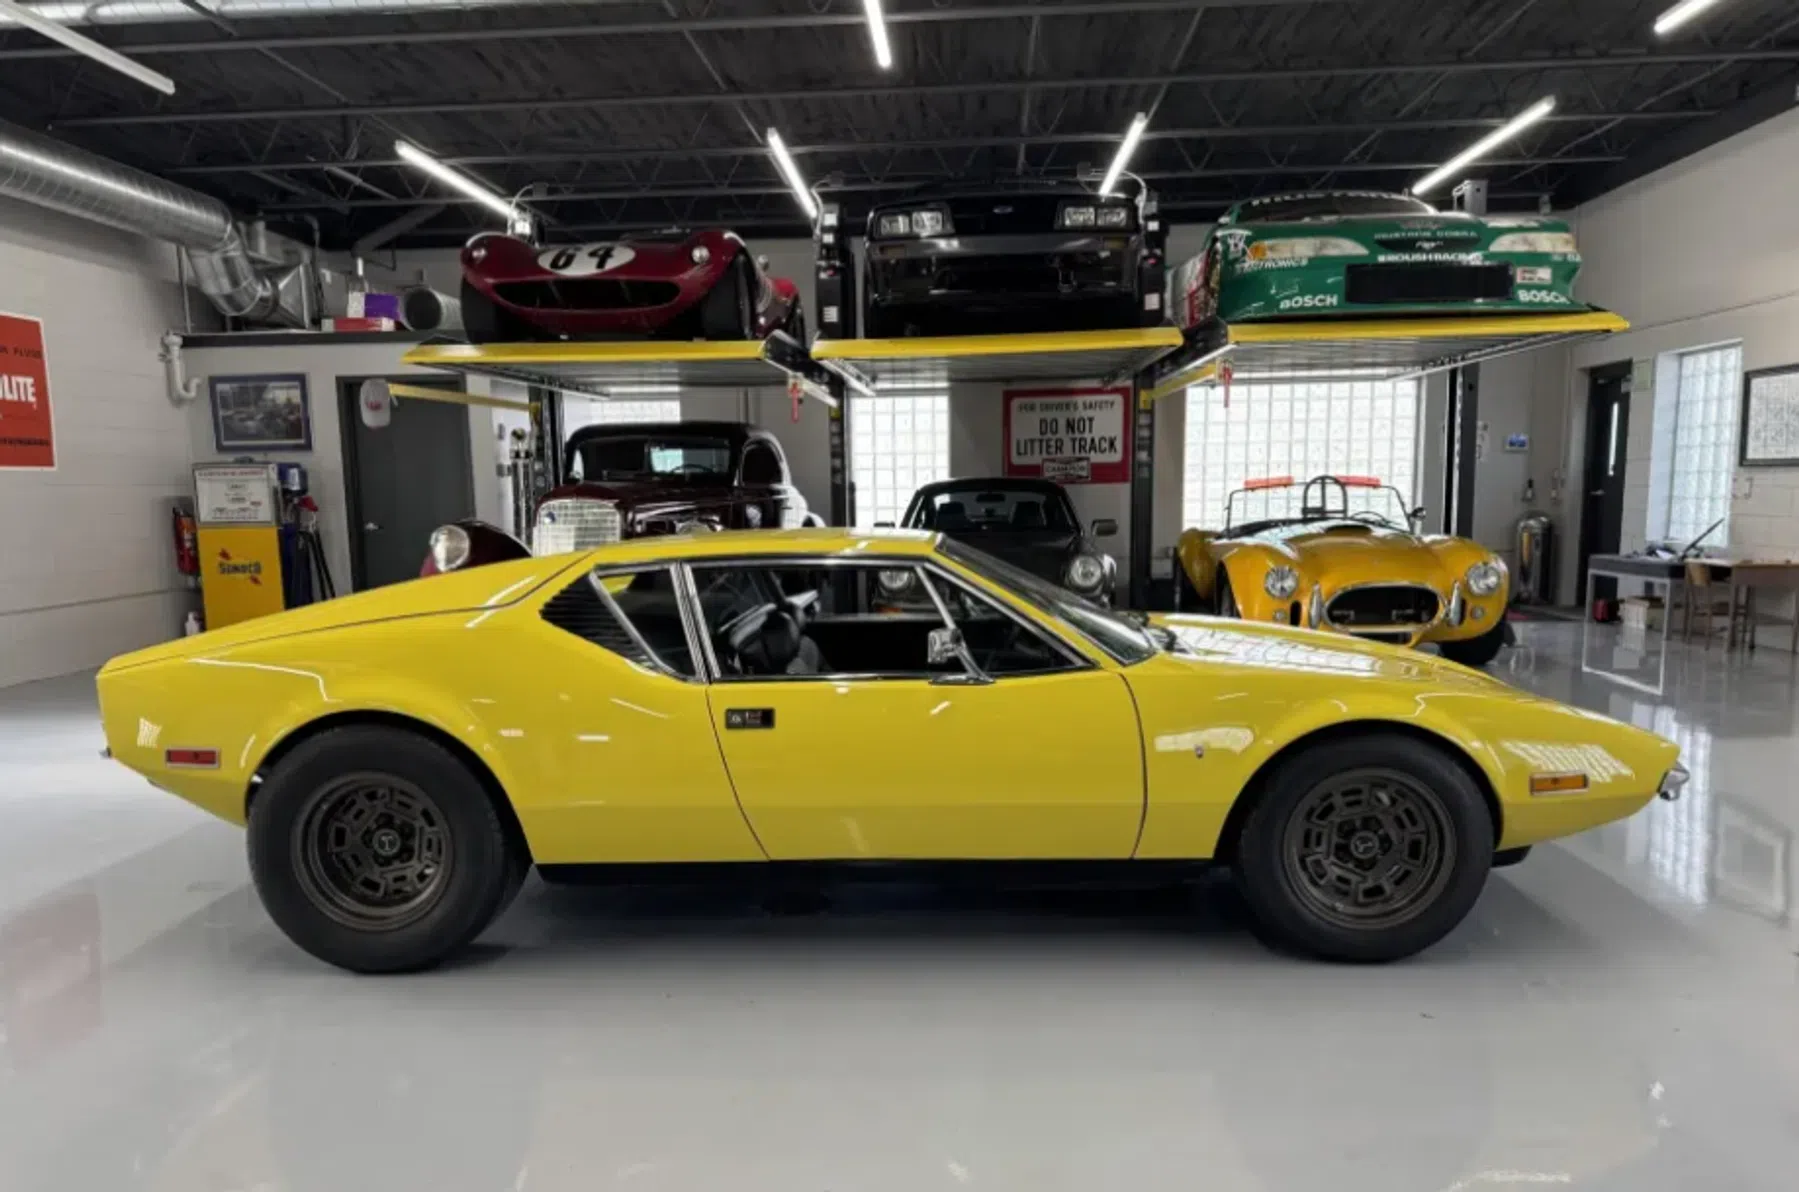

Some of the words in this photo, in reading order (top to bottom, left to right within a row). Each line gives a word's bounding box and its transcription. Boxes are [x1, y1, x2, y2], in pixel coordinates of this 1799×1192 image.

[550, 246, 614, 271] 64
[1280, 294, 1338, 309] BOSCH
[0, 373, 36, 402] LITE
[1018, 400, 1037, 412] FOR
[1039, 400, 1078, 412] DRIVER'S
[1082, 400, 1115, 411] SAFETY
[1039, 417, 1058, 435] DO
[1066, 416, 1094, 435] NOT
[1016, 438, 1064, 456] LITTER
[1069, 436, 1117, 455] TRACK
